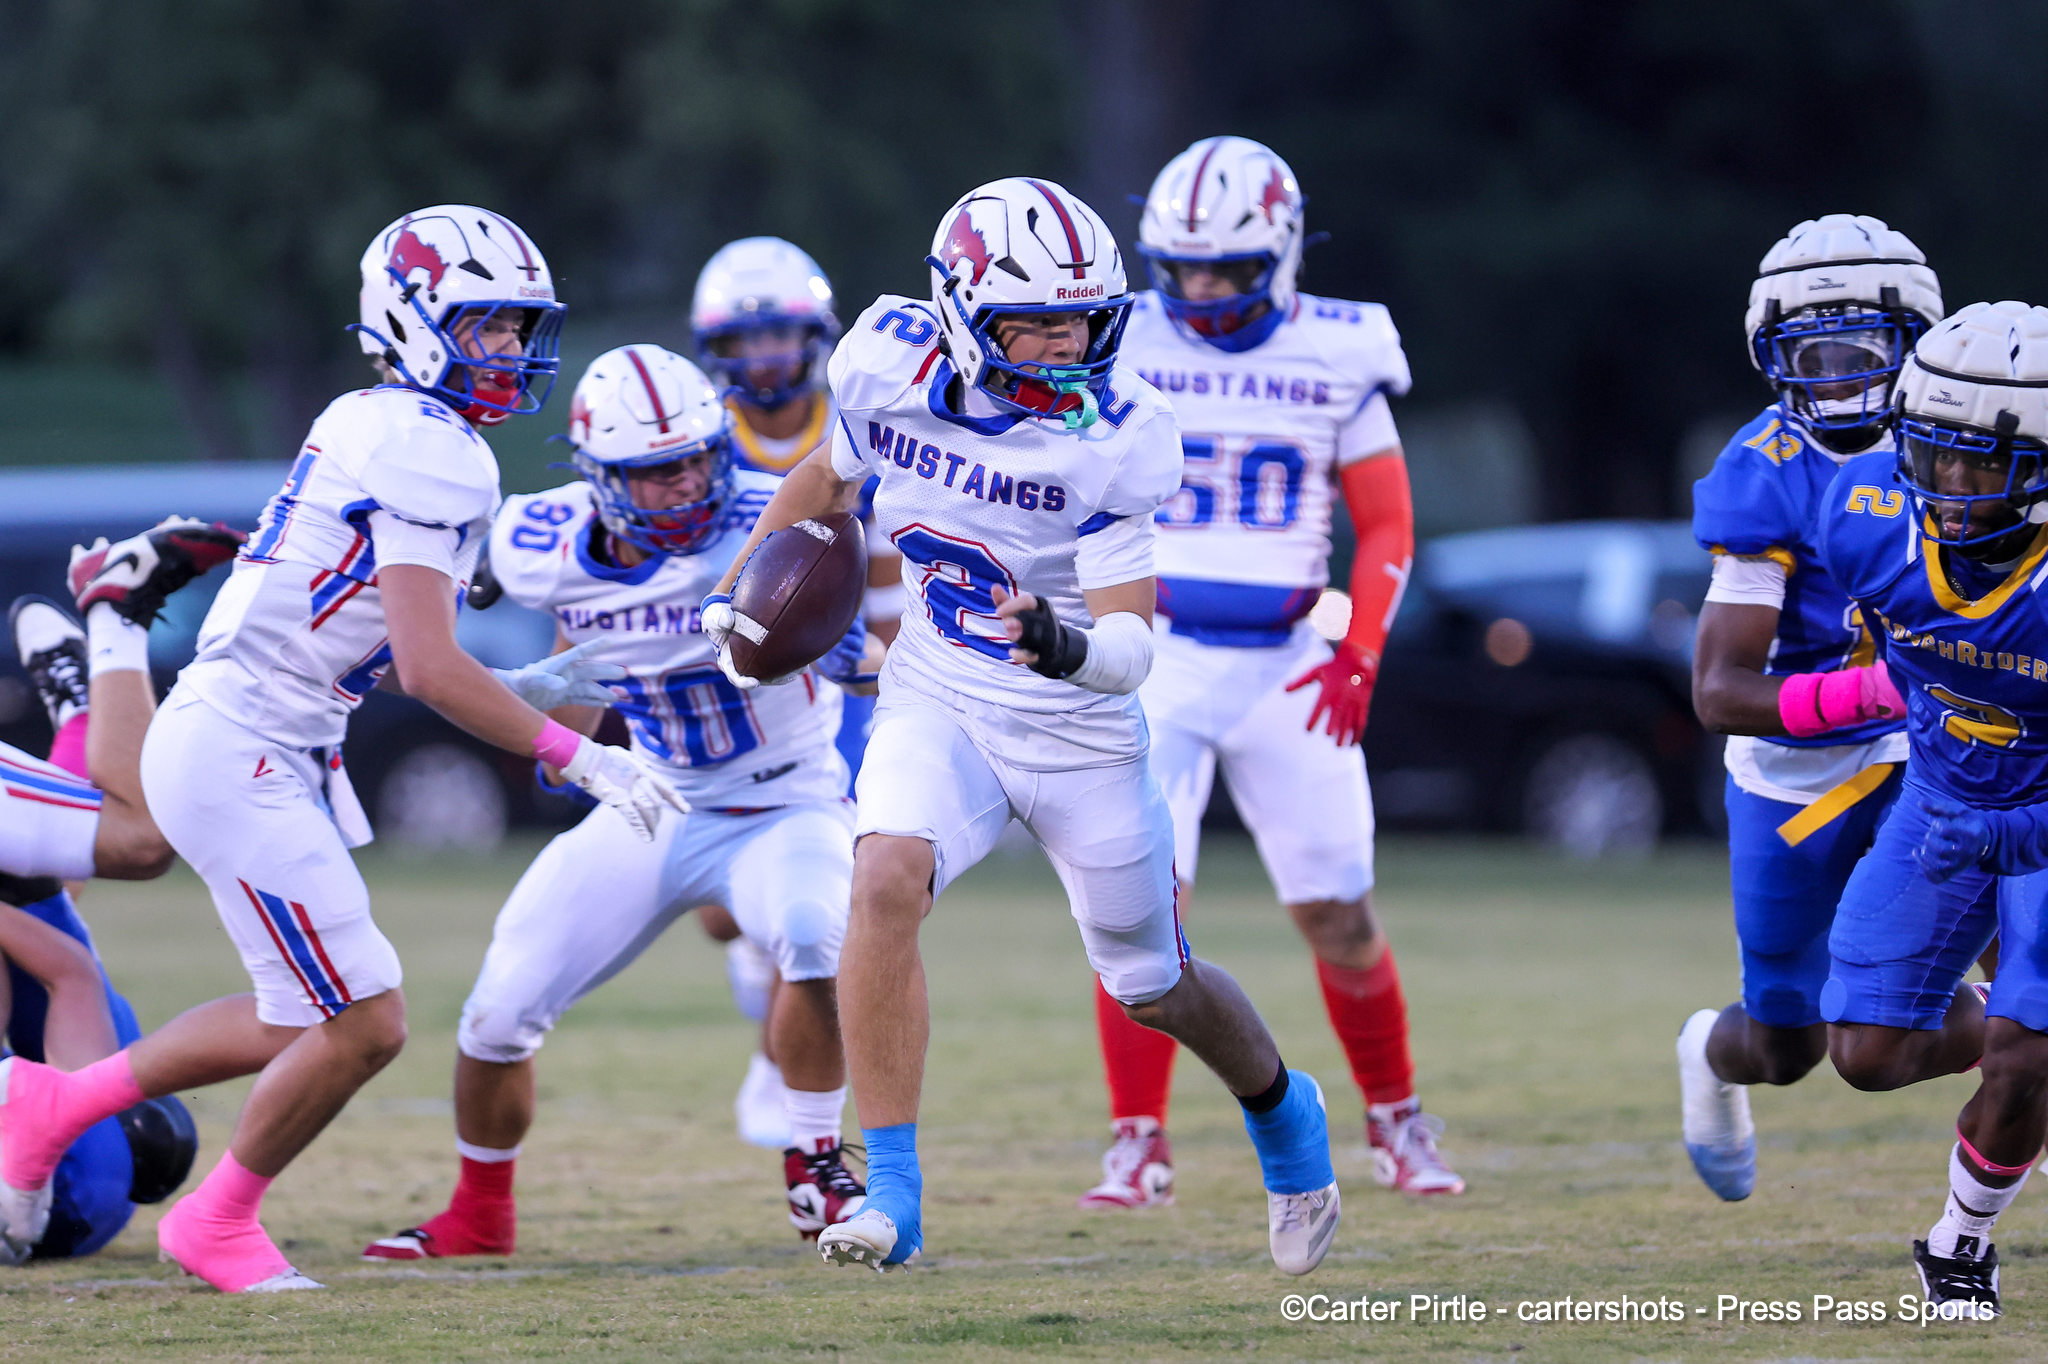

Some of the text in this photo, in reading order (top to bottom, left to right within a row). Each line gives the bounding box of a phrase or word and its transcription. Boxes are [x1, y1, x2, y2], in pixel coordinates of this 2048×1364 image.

[1057, 284, 1104, 299] Riddell
[873, 307, 938, 348] 2
[868, 420, 1067, 512] MUSTANGS
[1742, 417, 1804, 467] 12
[1154, 432, 1313, 532] 50
[1845, 484, 1906, 519] 2
[510, 499, 574, 553] 30
[891, 522, 1019, 665] 2
